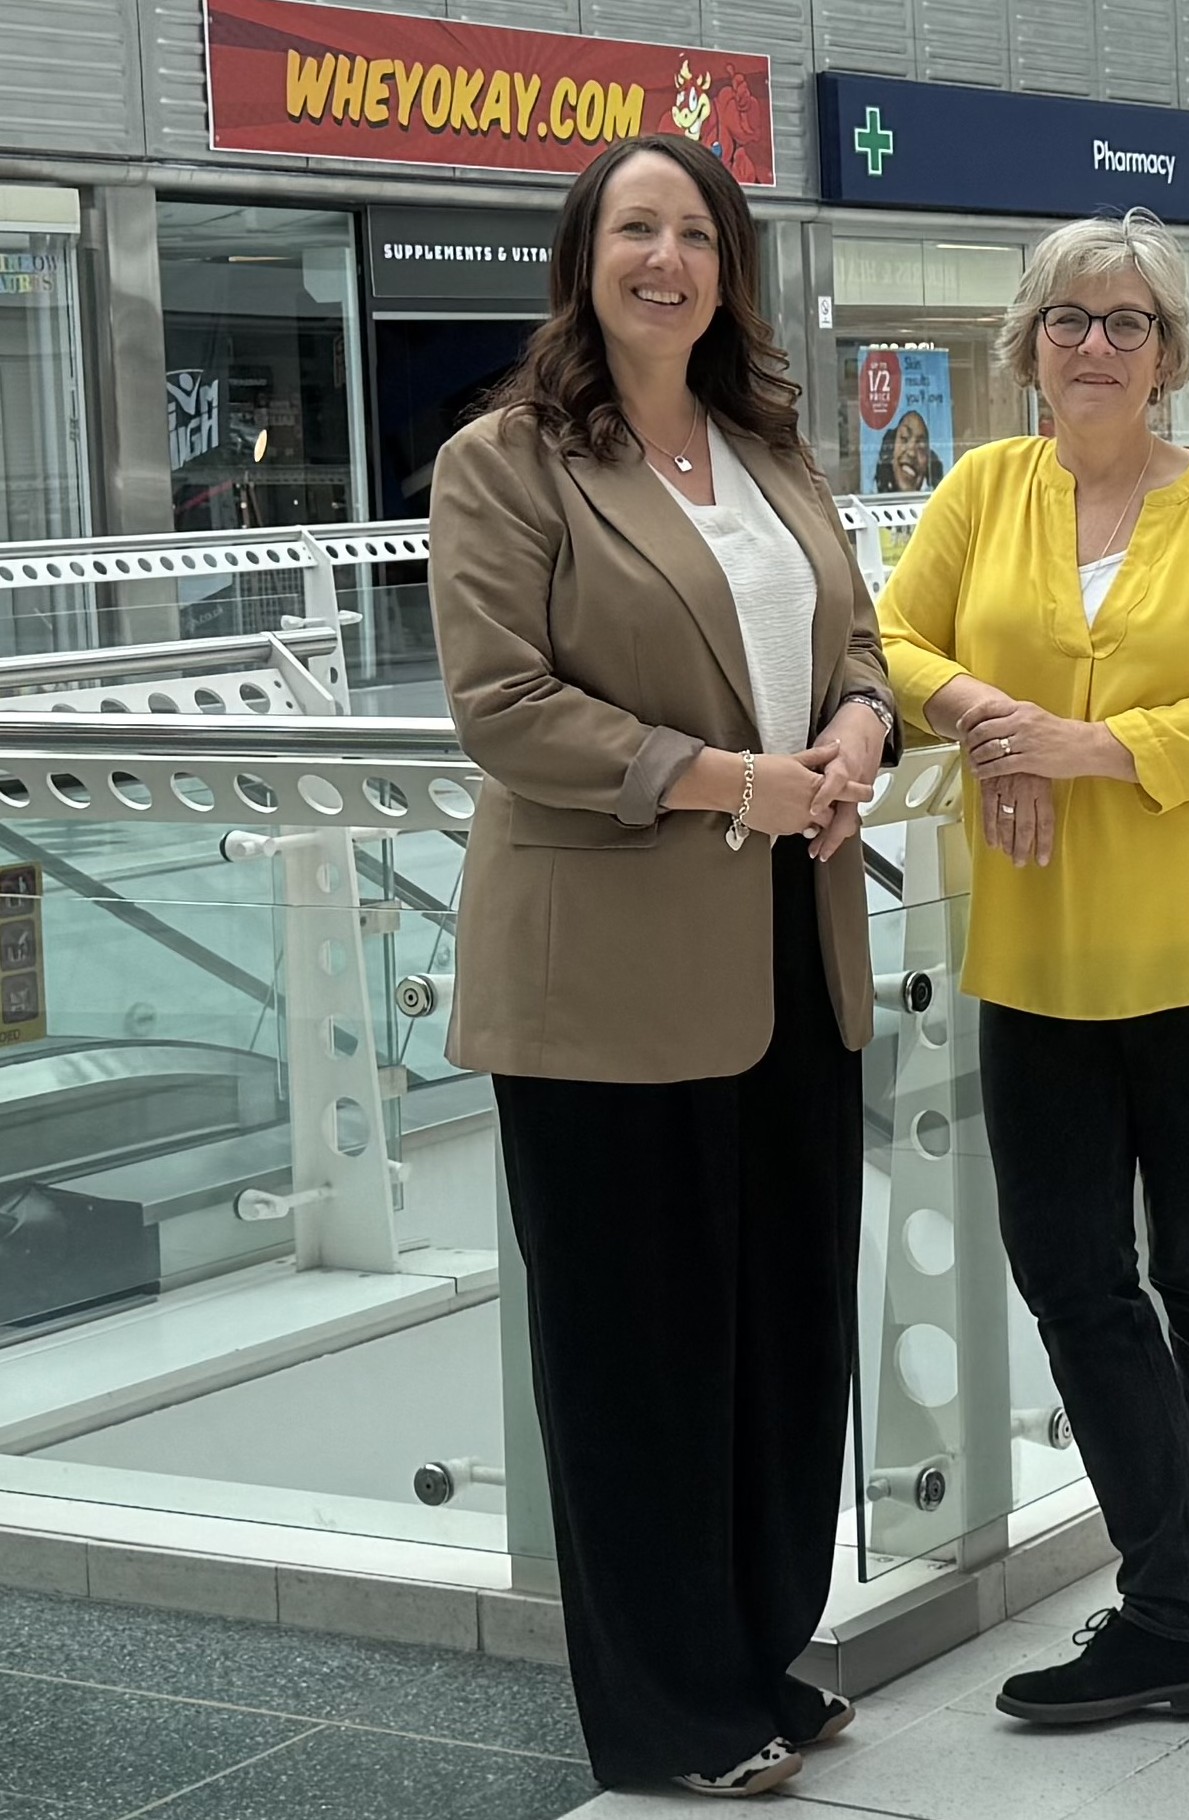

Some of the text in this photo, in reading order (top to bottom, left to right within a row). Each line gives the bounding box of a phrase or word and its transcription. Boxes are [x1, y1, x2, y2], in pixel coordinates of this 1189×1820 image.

[287, 49, 644, 142] WHEYOKAY.COM
[1093, 139, 1176, 184] Pharmacy
[384, 243, 492, 261] SUPPLEMENTS
[497, 246, 507, 262] &
